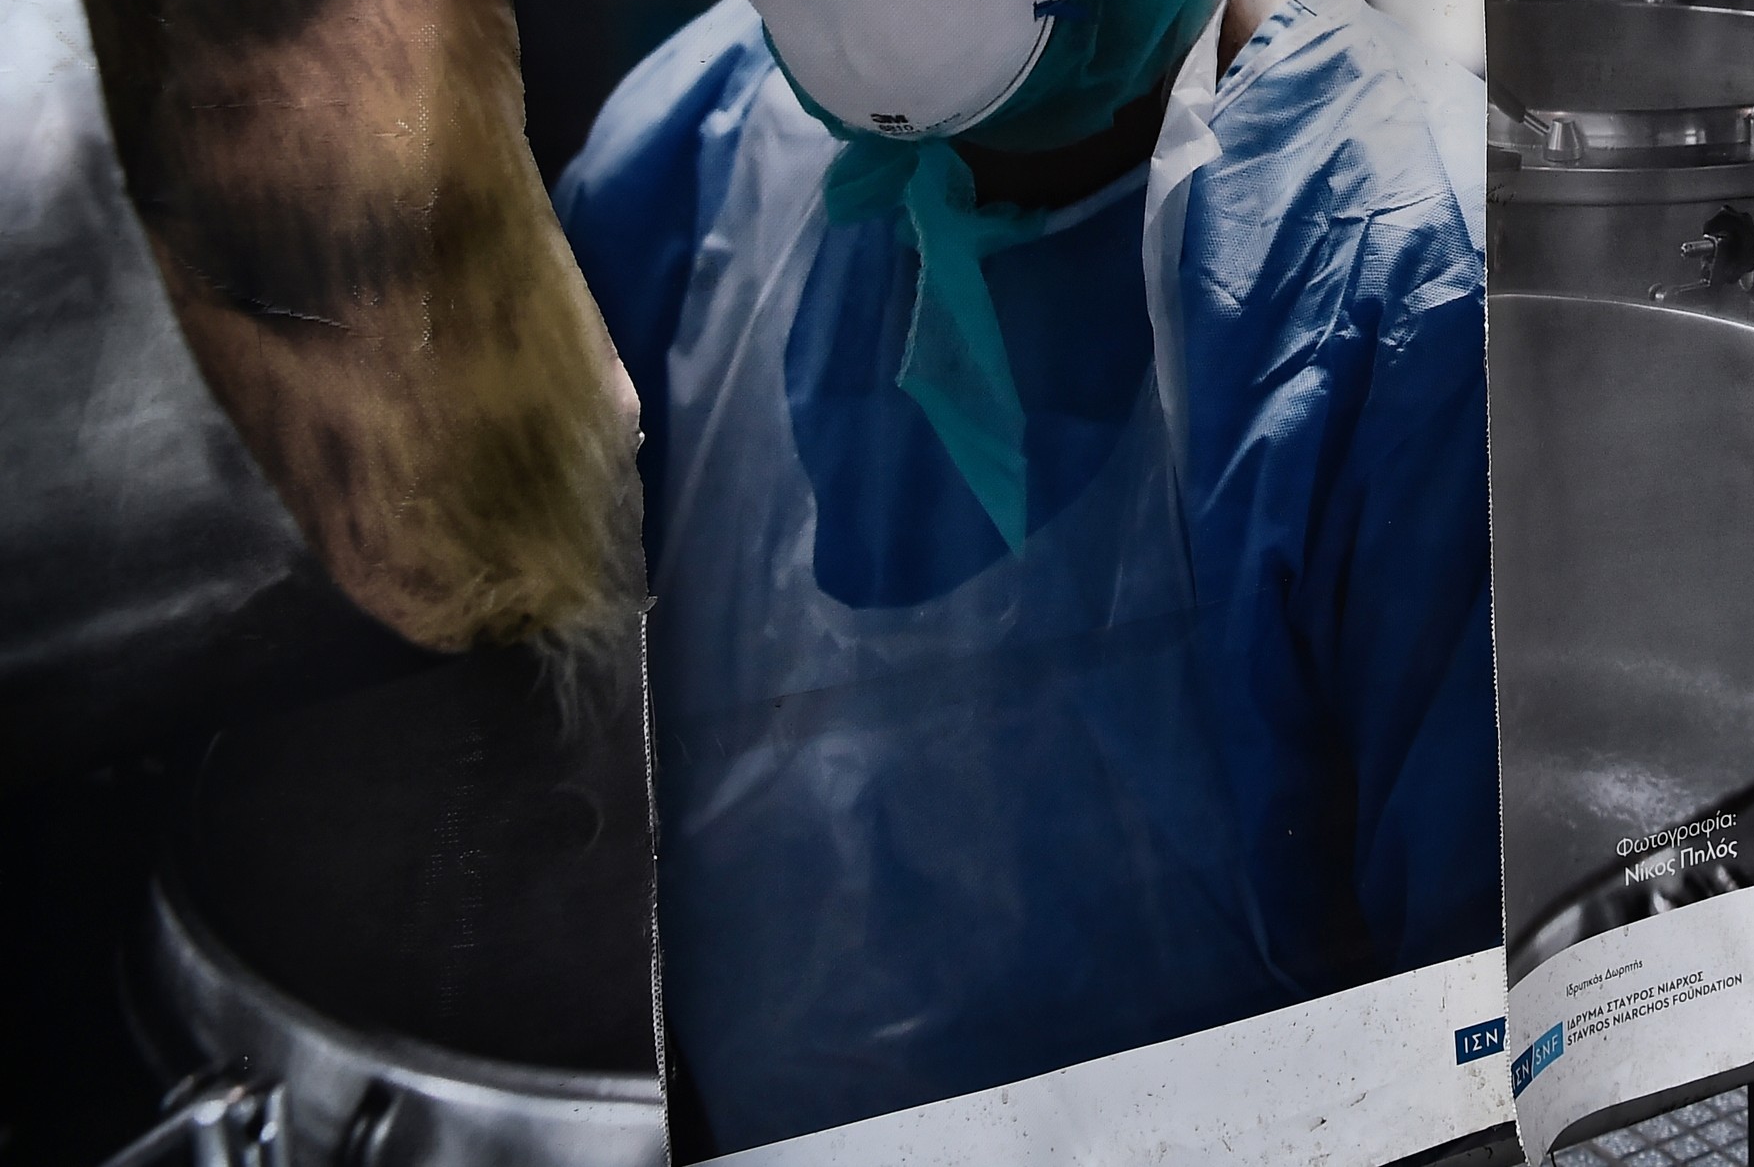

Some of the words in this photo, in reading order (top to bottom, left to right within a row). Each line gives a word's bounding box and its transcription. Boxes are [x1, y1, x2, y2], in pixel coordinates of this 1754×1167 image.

[1616, 810, 1736, 857] Φωτογραφία:
[1625, 858, 1675, 886] Νίκος
[1680, 837, 1738, 869] Πηλός
[1566, 973, 1603, 998] Ιδρυτικός
[1605, 959, 1643, 980] Δωρητής
[1567, 1005, 1604, 1031] ΙΔΡΥΜΑ
[1607, 987, 1654, 1013] ΣΤΑΥΡΟΣ
[1657, 971, 1704, 995] ΝΙΑΡΧΟΣ
[1567, 1018, 1610, 1046] STAVROS
[1613, 997, 1670, 1026] NIARCHOS
[1672, 973, 1743, 1006] FOUNDATION
[1464, 1028, 1498, 1054] ΙΣΝ
